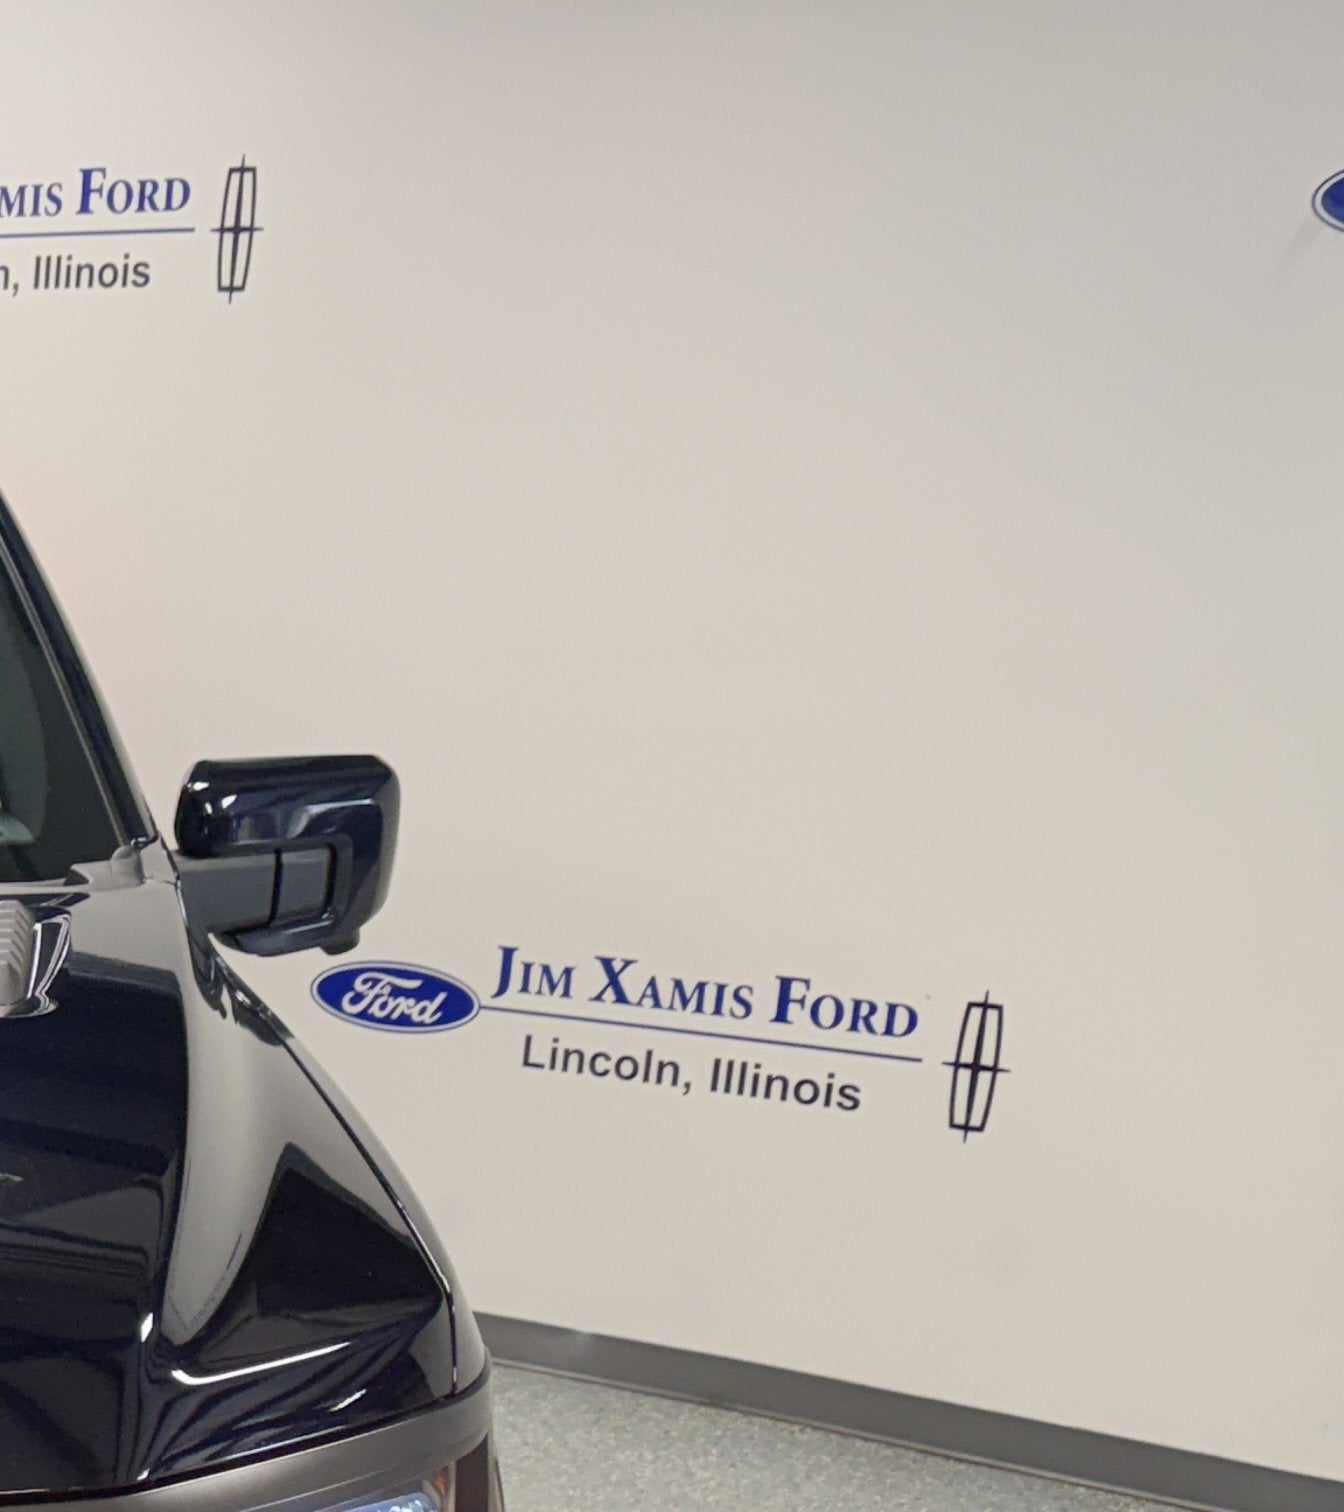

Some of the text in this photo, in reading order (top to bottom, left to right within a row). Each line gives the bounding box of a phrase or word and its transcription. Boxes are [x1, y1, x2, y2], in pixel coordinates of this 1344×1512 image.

[33, 253, 151, 290] Illinois
[341, 971, 446, 1025] Ford
[521, 1034, 861, 1112] Lincoln, Illinois
